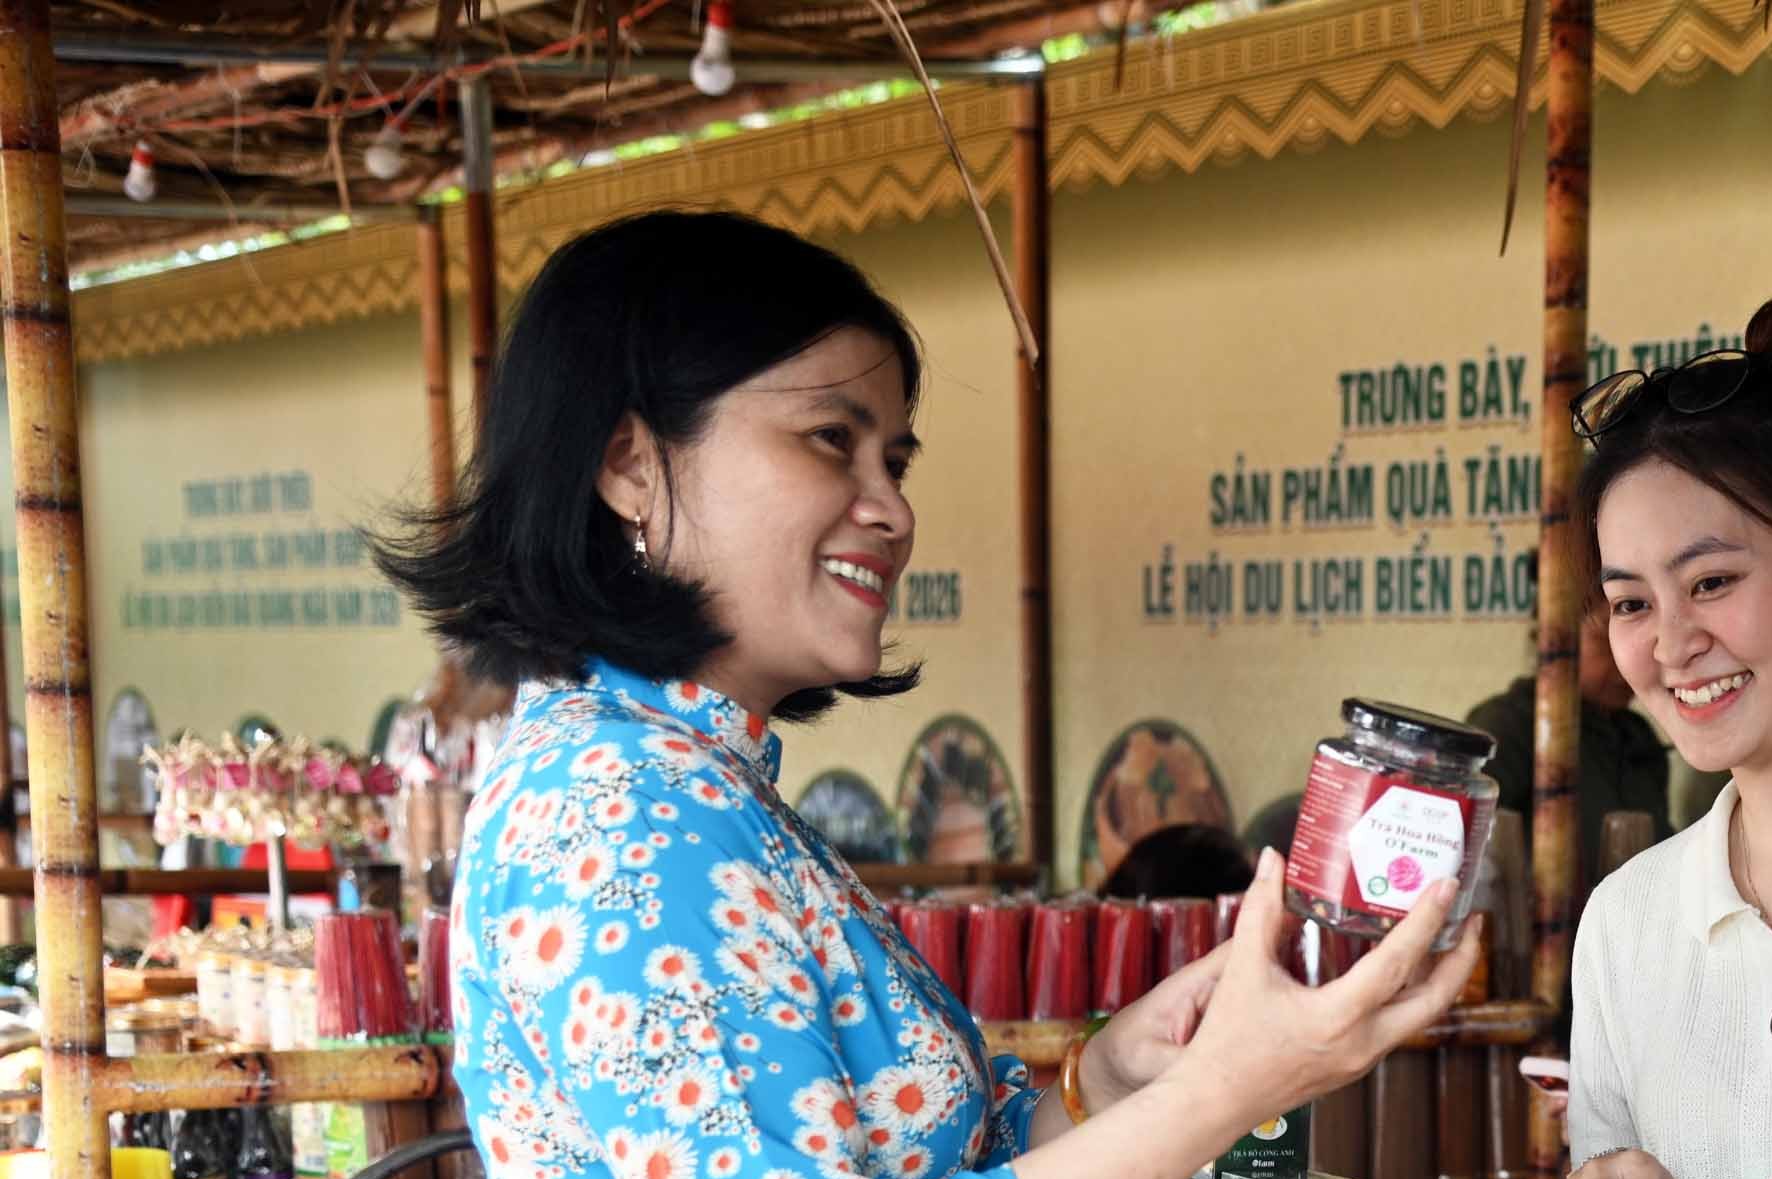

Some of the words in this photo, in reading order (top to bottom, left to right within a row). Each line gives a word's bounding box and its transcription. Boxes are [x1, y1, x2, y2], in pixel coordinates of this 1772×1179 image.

[1338, 363, 1447, 428] TRƯNG
[1458, 345, 1530, 419] BÀY,
[1210, 451, 1271, 526] SẢN
[1282, 443, 1374, 526] PHẨM
[1387, 447, 1451, 524] QUÀ
[1464, 446, 1543, 532] TẶN
[1143, 543, 1175, 615] LỄ
[1184, 550, 1232, 629] HỘI
[1244, 560, 1283, 614] DU
[1294, 558, 1363, 628] LỊCH
[1375, 532, 1451, 613] BIỂN
